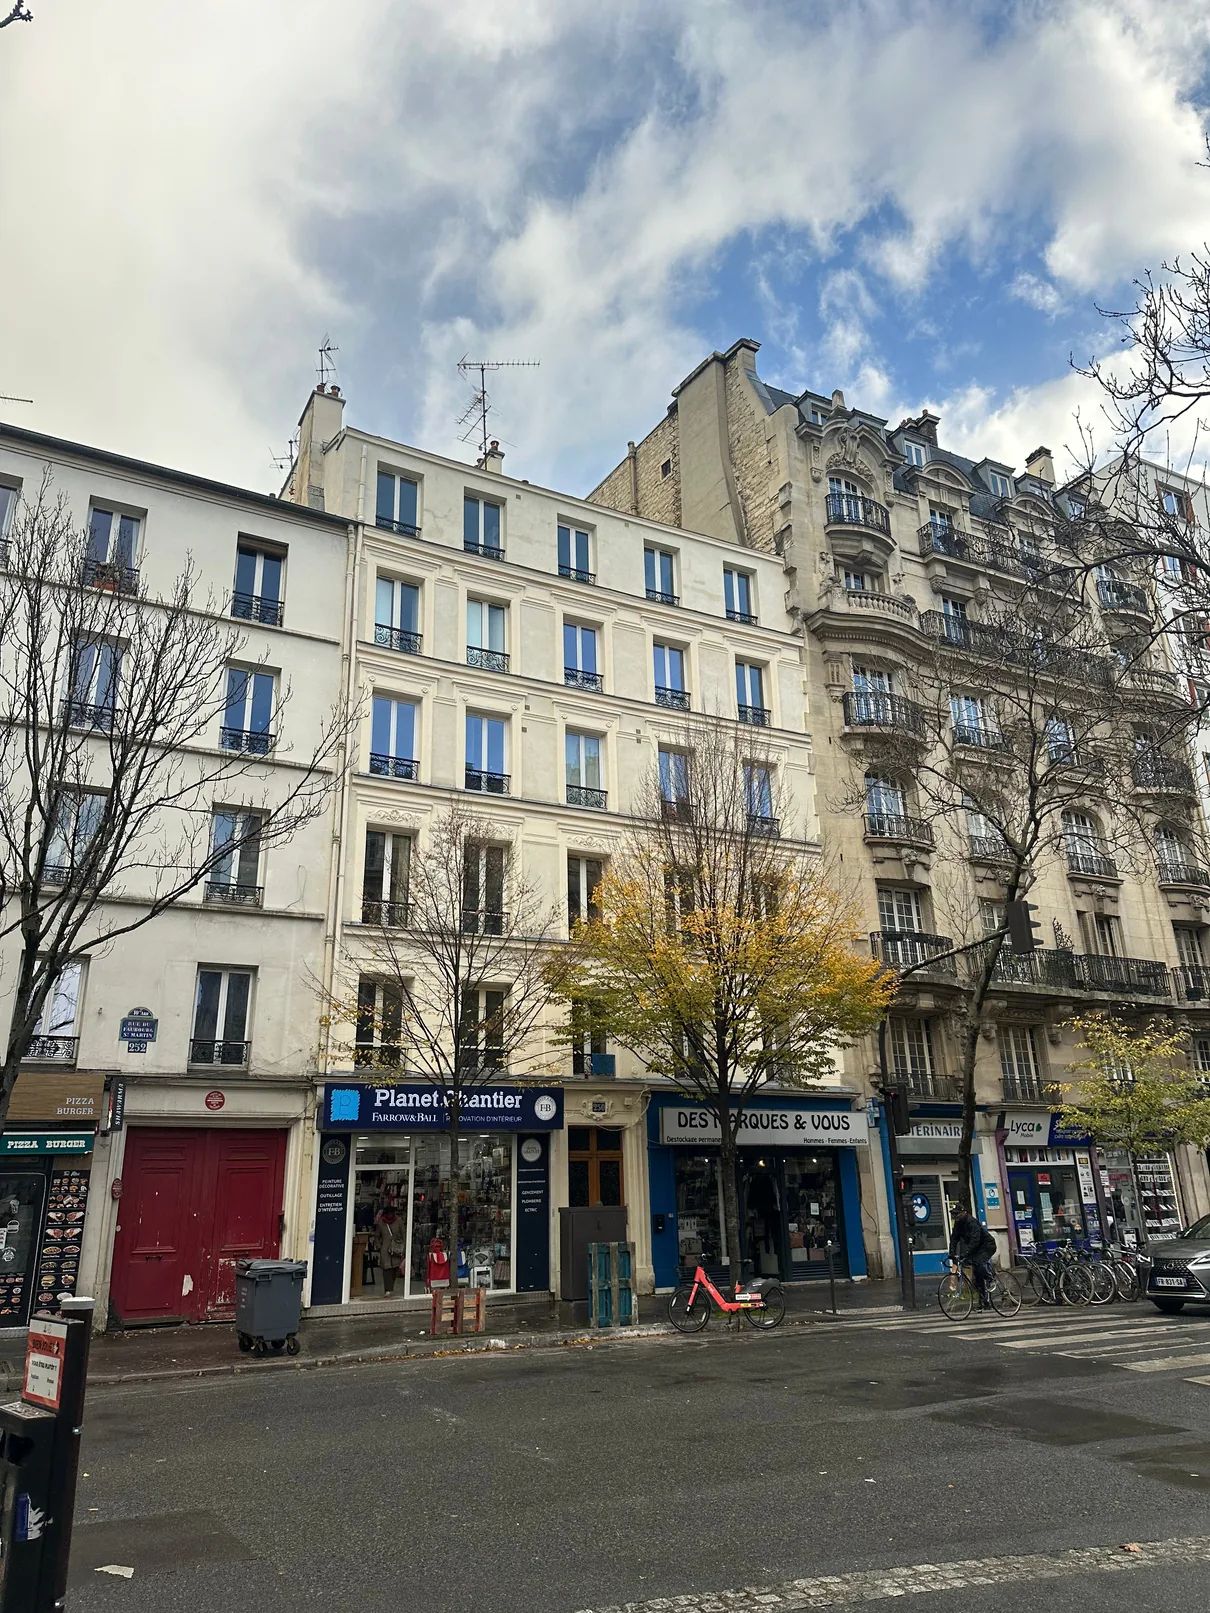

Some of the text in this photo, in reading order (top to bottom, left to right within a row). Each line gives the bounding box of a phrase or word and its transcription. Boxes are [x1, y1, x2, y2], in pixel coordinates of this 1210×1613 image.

[129, 1043, 146, 1052] 252
[66, 1097, 94, 1105] PIZZA
[115, 1083, 124, 1125] SHAWARMA
[56, 1107, 94, 1115] BURGER
[677, 1111, 709, 1129] DES
[794, 1114, 807, 1130] &
[811, 1114, 850, 1131] VOUS
[1011, 1120, 1035, 1134] Lyca
[7, 1139, 85, 1149] PIZZA BURGER
